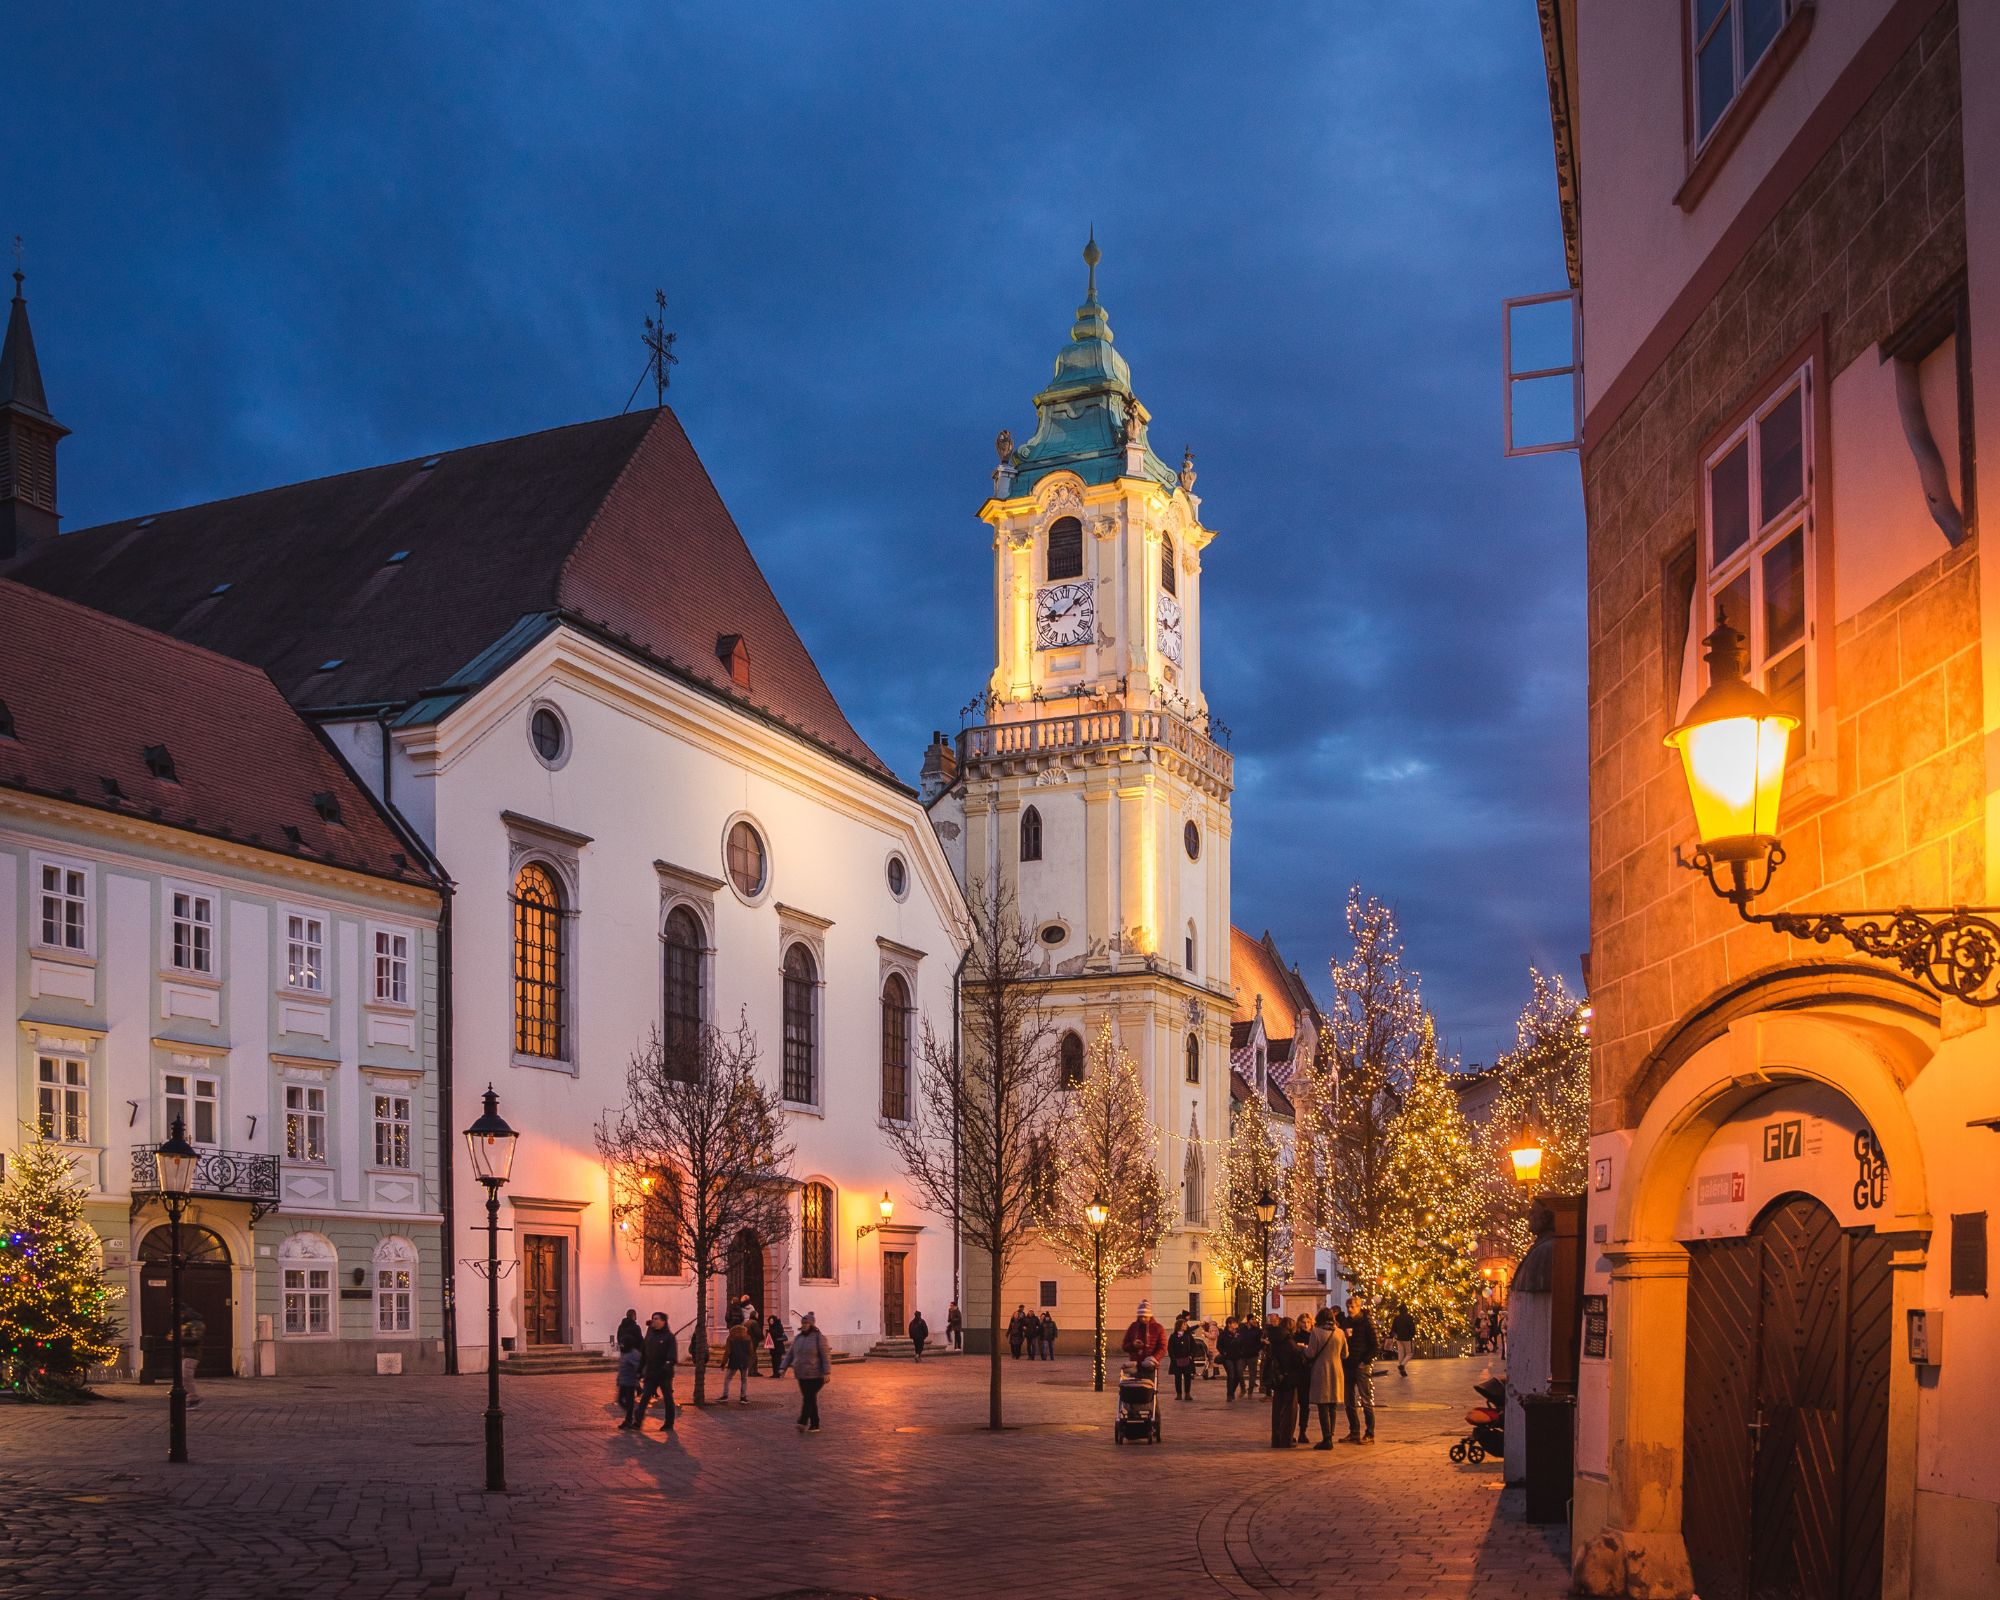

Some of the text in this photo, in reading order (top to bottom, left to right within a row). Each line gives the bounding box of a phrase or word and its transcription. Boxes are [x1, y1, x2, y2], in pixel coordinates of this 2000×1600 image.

[1050, 592, 1060, 604] XI
[1060, 588, 1070, 599] XII
[1042, 603, 1052, 611] X
[1081, 608, 1090, 616] III
[1061, 633, 1069, 642] VI
[1767, 1125, 1799, 1159] F7
[1732, 1178, 1744, 1198] F7
[1853, 1180, 1883, 1210] GU
